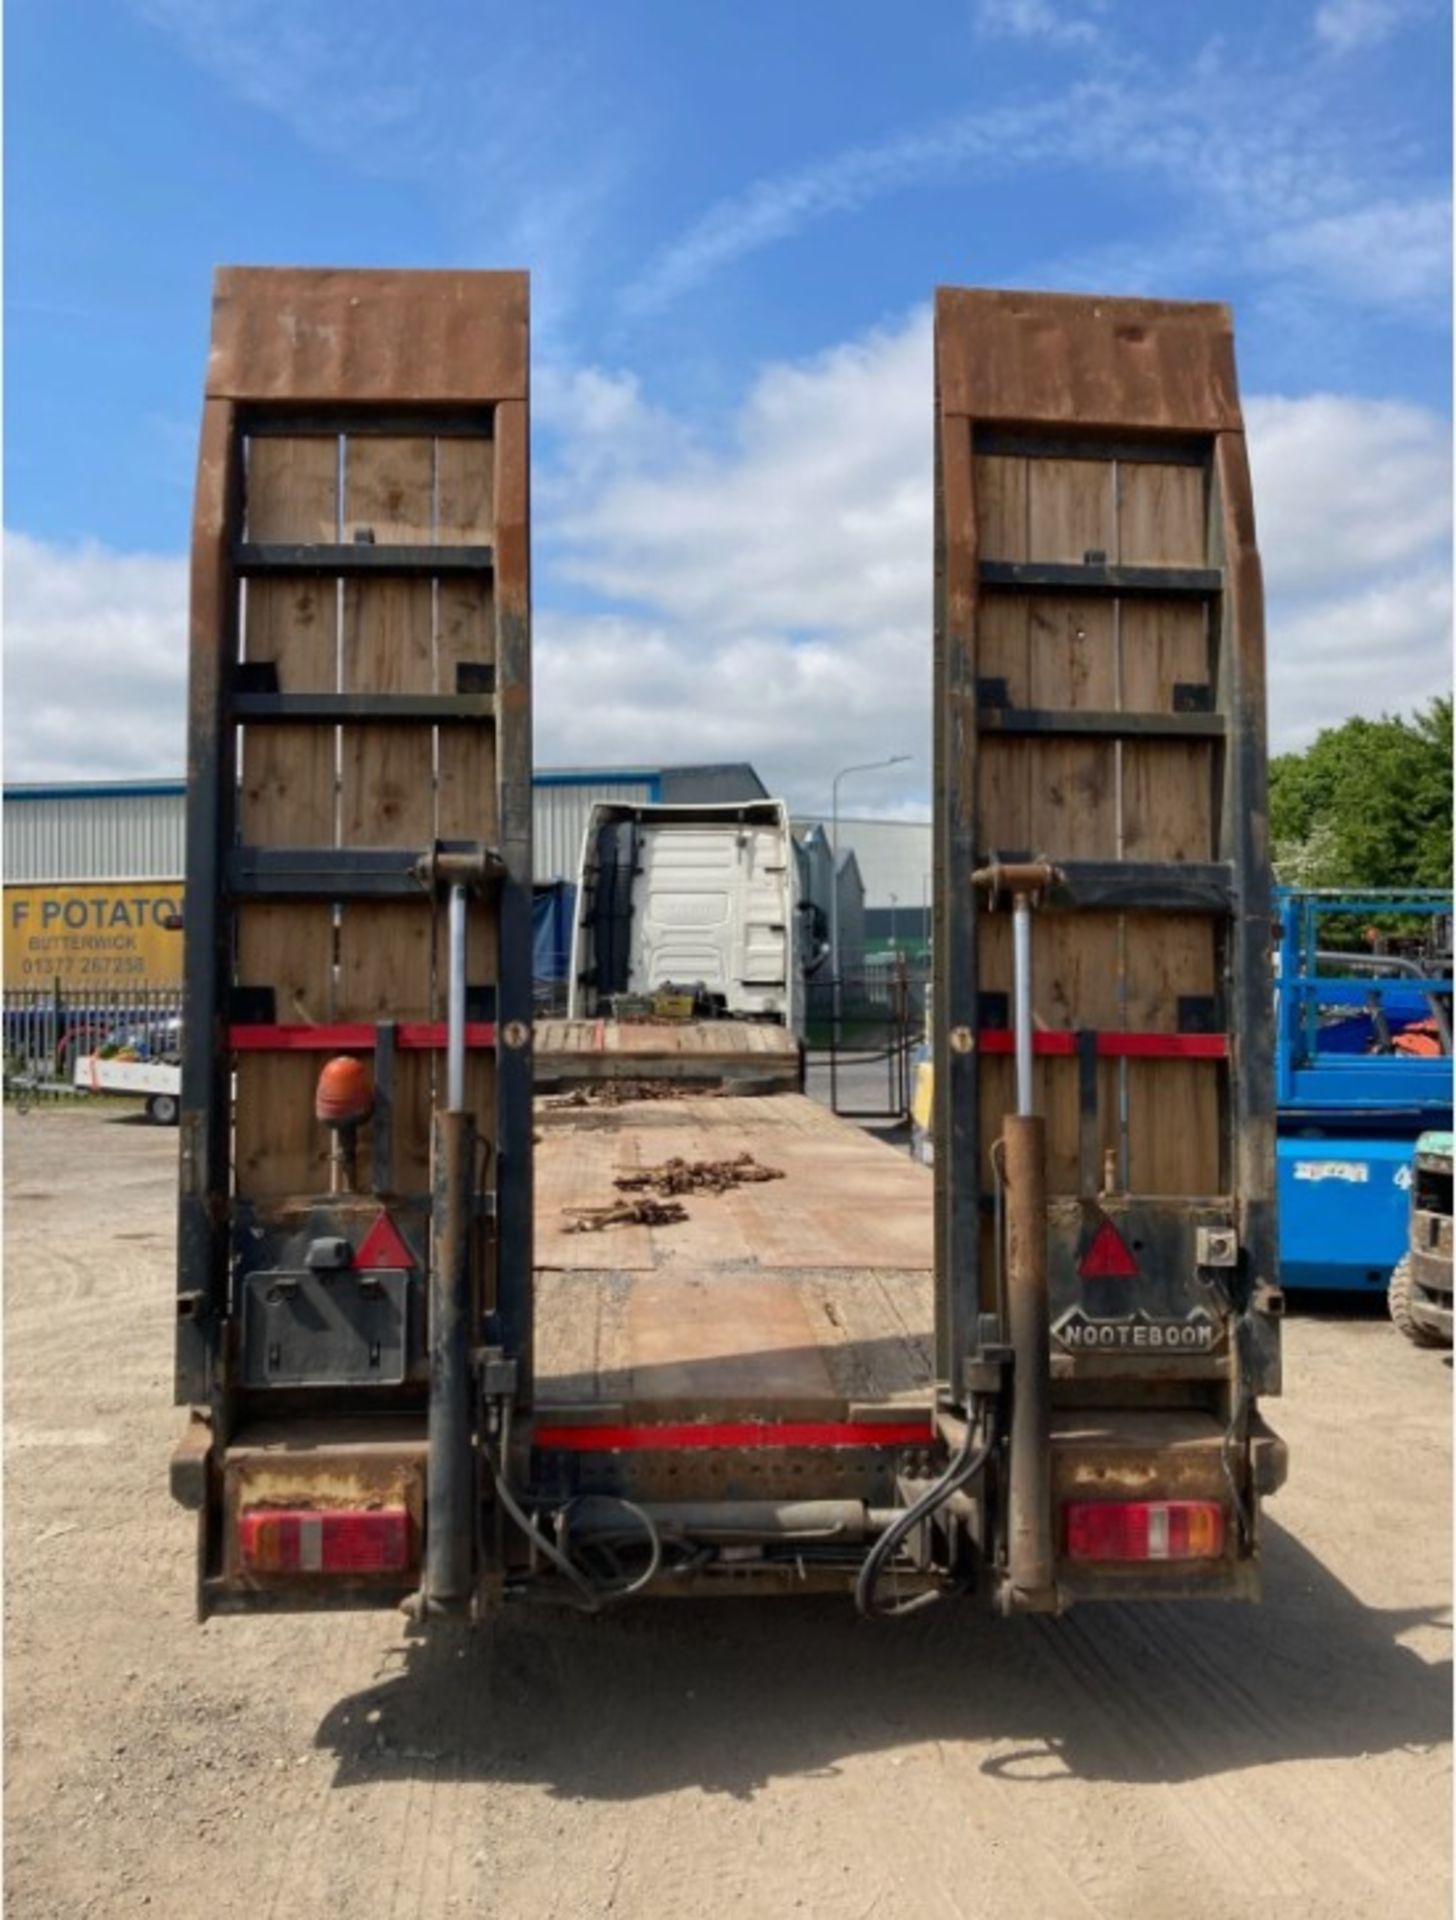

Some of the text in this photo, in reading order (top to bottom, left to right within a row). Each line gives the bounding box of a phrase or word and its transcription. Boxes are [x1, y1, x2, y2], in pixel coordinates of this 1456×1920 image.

[12, 901, 30, 929] F
[28, 934, 138, 951] BUTTERWICK
[1064, 1325, 1212, 1347] NOOTEBOOM
